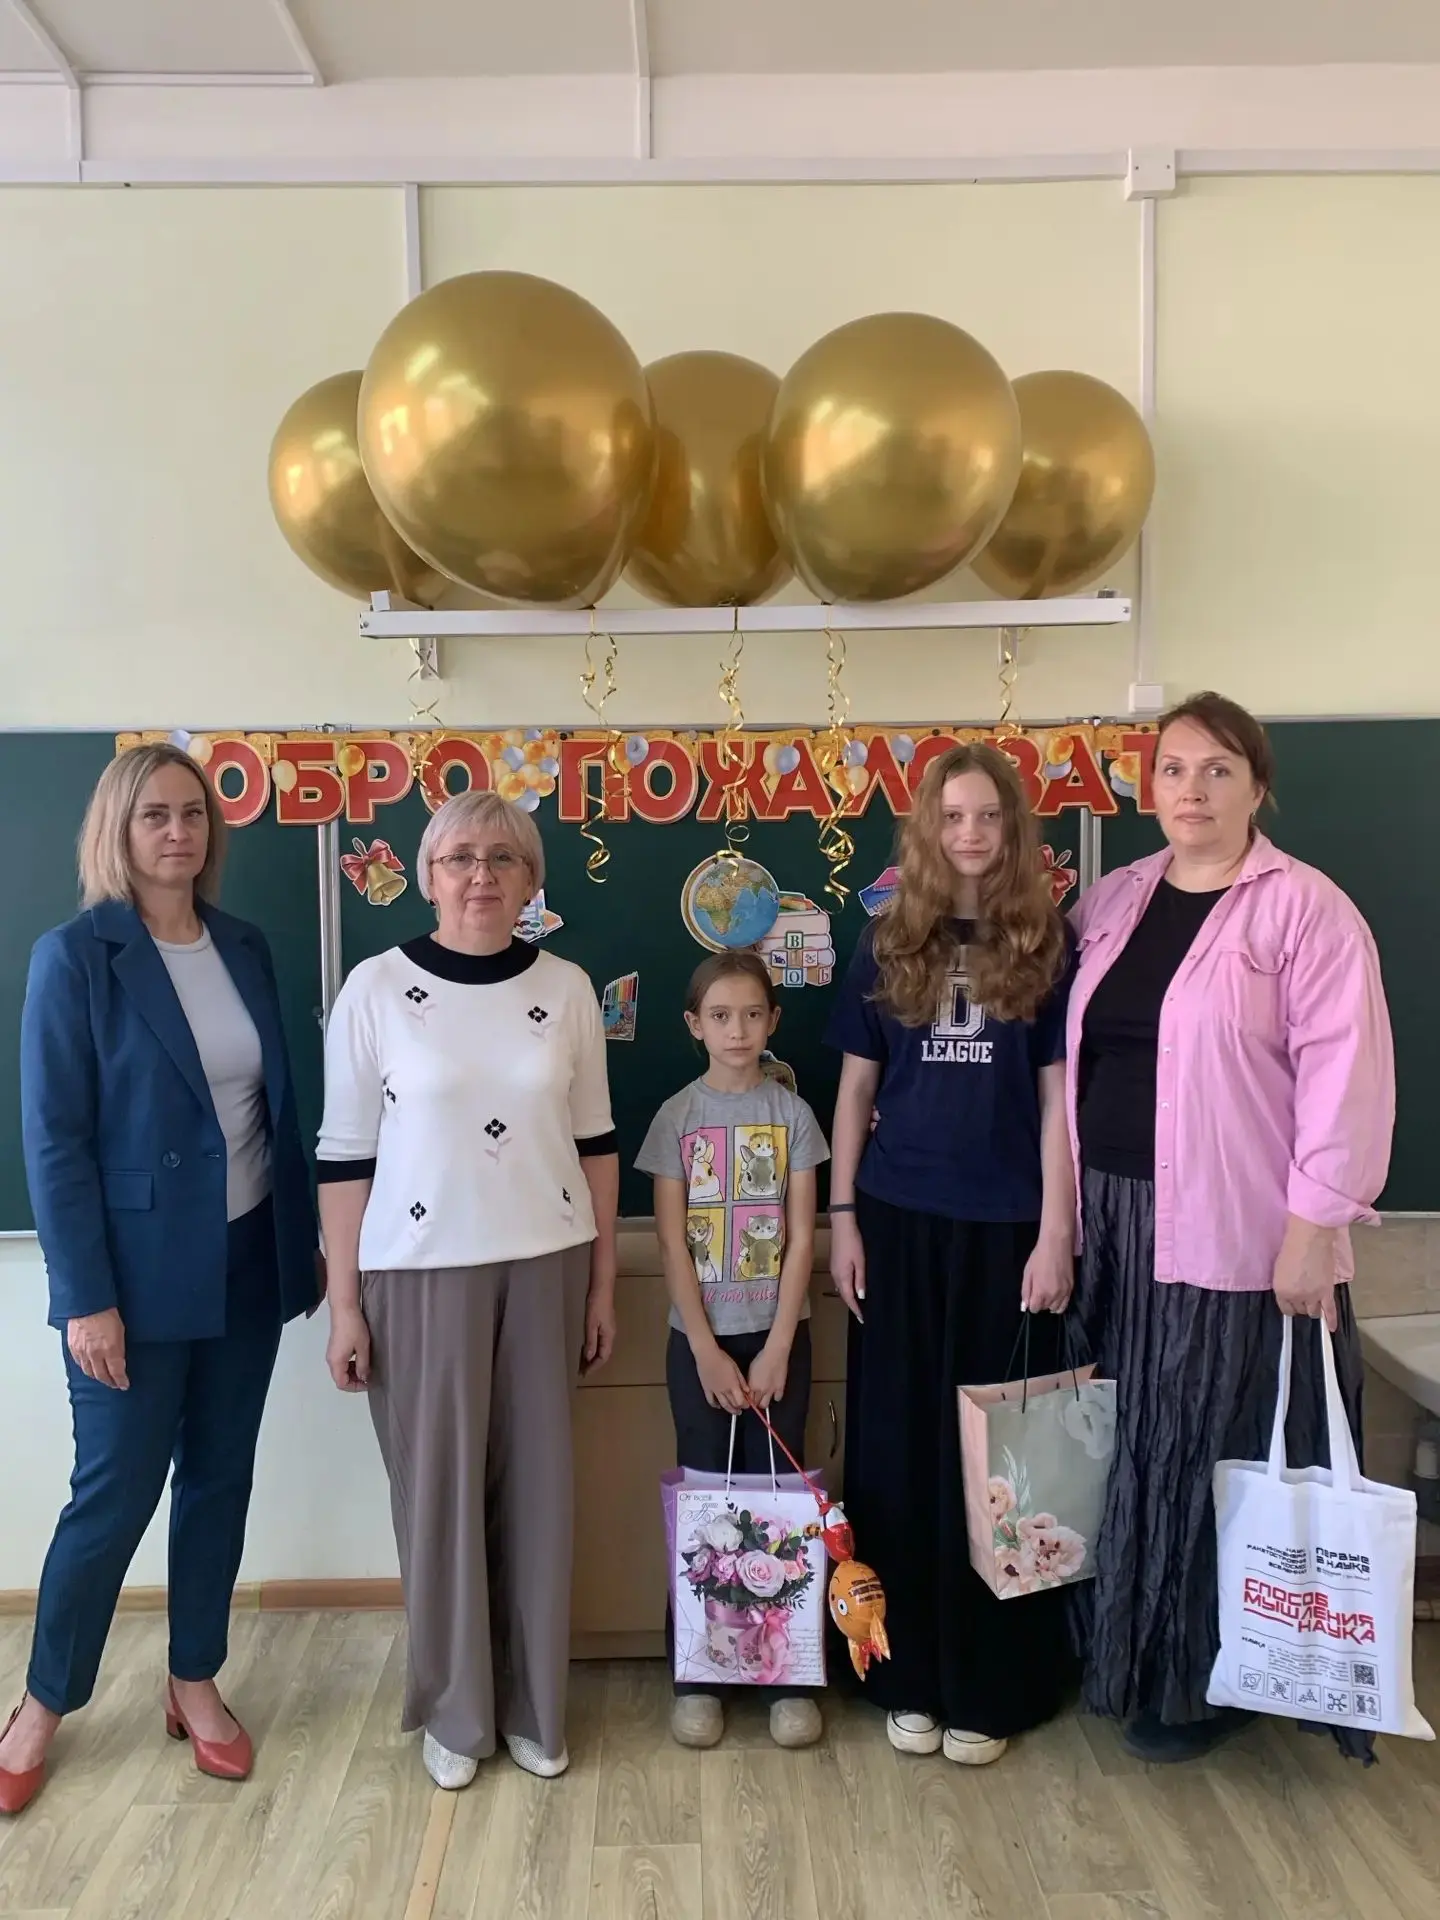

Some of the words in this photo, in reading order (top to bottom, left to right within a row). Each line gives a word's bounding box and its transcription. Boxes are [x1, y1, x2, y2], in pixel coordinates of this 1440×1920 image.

[203, 737, 493, 827] ОБРО
[921, 1040, 994, 1063] LEAGUE
[1315, 1547, 1370, 1565] ПЕРВЫЕ
[1327, 1560, 1371, 1573] НАУКЕ
[1245, 1577, 1329, 1608] СПОСОБ
[1243, 1590, 1375, 1630] МЫШЛЕНИЯ
[1298, 1619, 1376, 1645] НАУКА
